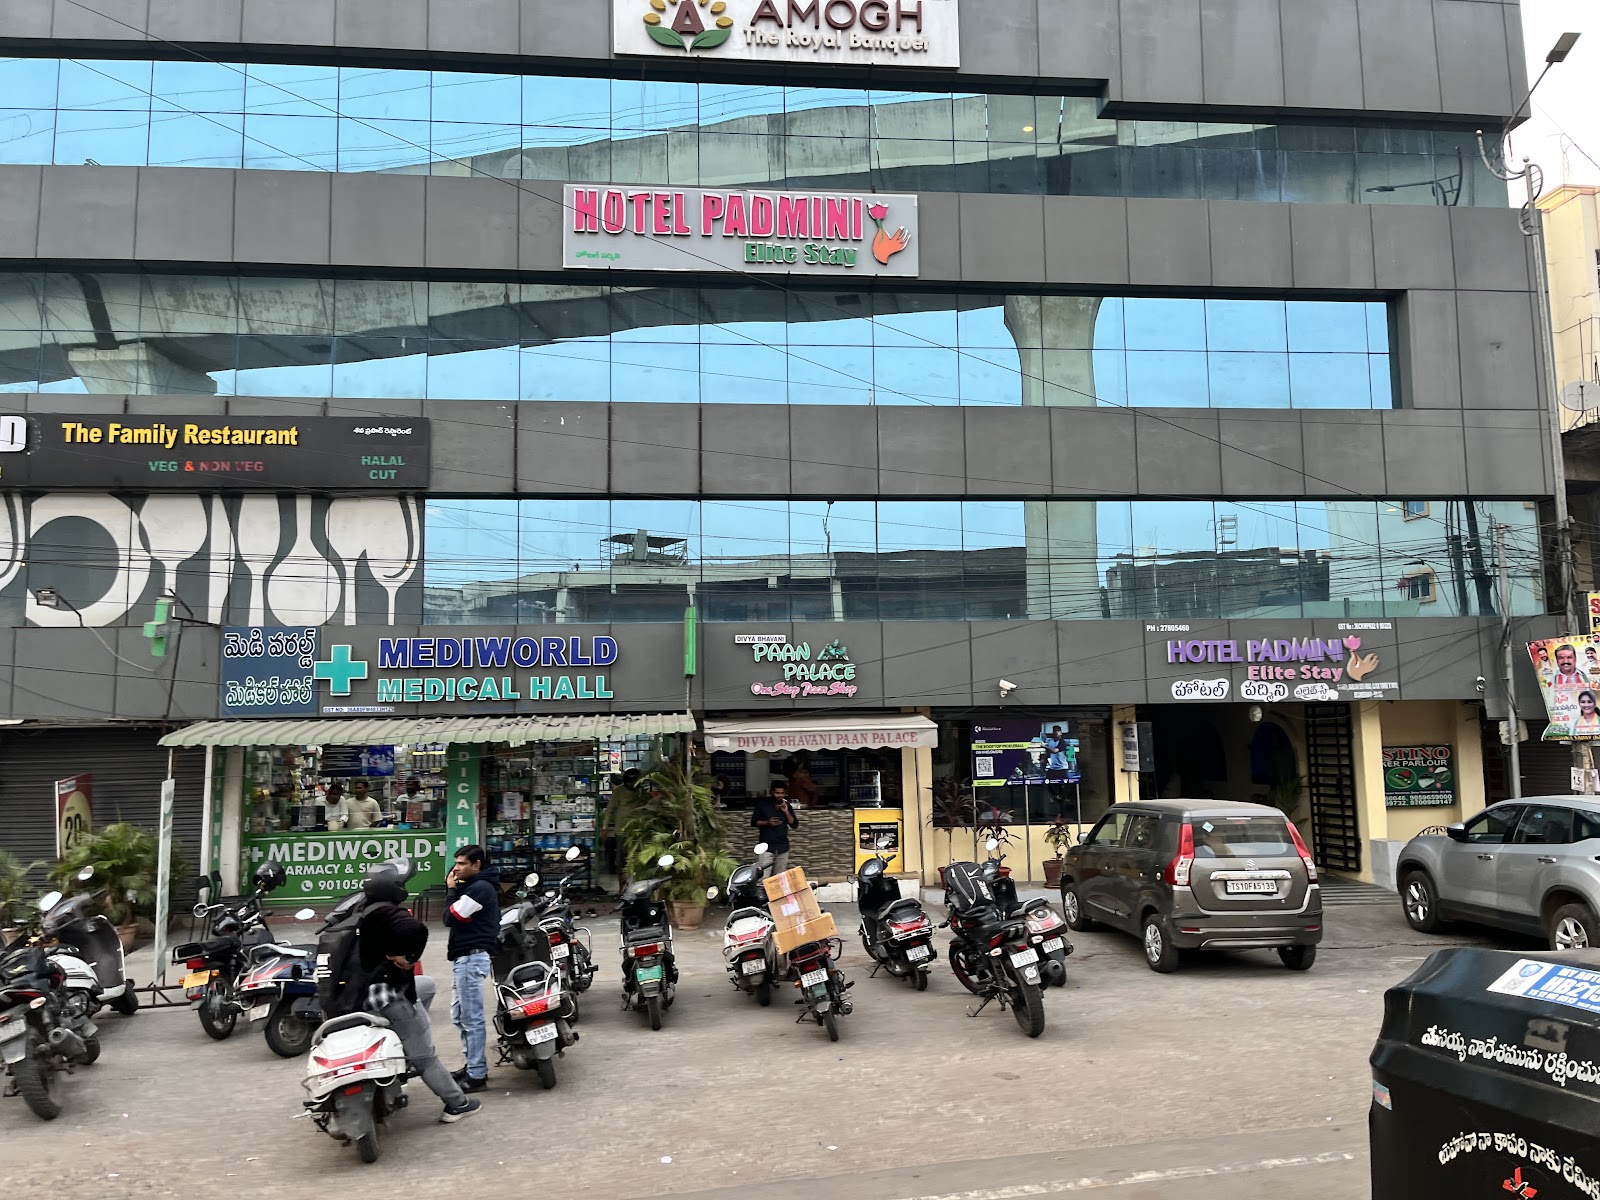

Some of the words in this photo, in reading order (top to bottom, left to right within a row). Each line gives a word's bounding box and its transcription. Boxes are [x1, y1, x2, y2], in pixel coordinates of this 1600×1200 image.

[750, 0, 923, 32] AMOGH
[744, 27, 779, 47] The
[788, 28, 842, 50] Royal
[573, 188, 692, 236] HOTEL
[701, 192, 864, 240] PADMINI
[744, 241, 799, 264] Elite
[804, 243, 859, 268] Stay
[62, 422, 102, 443] The
[107, 424, 177, 450] Family
[184, 424, 298, 446] Restaurant
[148, 460, 178, 473] VEG
[184, 460, 195, 473] &
[200, 460, 231, 473] NON
[234, 460, 264, 473] VEG
[361, 455, 406, 466] HALAL
[369, 469, 397, 480] CUT
[1146, 624, 1156, 632] PH
[1160, 624, 1190, 632] 27805460
[223, 627, 264, 658] మెడి
[377, 635, 618, 669] MEDIWORLD
[752, 641, 811, 662] PAAN
[1167, 639, 1244, 663] HOTEL
[1246, 636, 1344, 663] PADMINI
[782, 663, 856, 681] PALACE
[1247, 665, 1296, 681] Elite
[1299, 664, 1344, 682] Stay
[225, 675, 279, 706] మెడికల్
[280, 675, 313, 705] హాల్
[377, 676, 521, 702] MEDICAL
[530, 675, 614, 700] HALL
[770, 681, 800, 698] Stop
[827, 681, 858, 697] Shop
[1175, 680, 1226, 697] హోటల్
[737, 735, 775, 748] DIVYA
[779, 733, 832, 747] BHAVANI
[836, 732, 869, 745] PAAN
[872, 731, 918, 744] PALACE
[1402, 759, 1448, 767] PARLOUR
[267, 838, 432, 863] MEDIWORLD
[345, 864, 354, 874] &
[1557, 967, 1579, 977] MY
